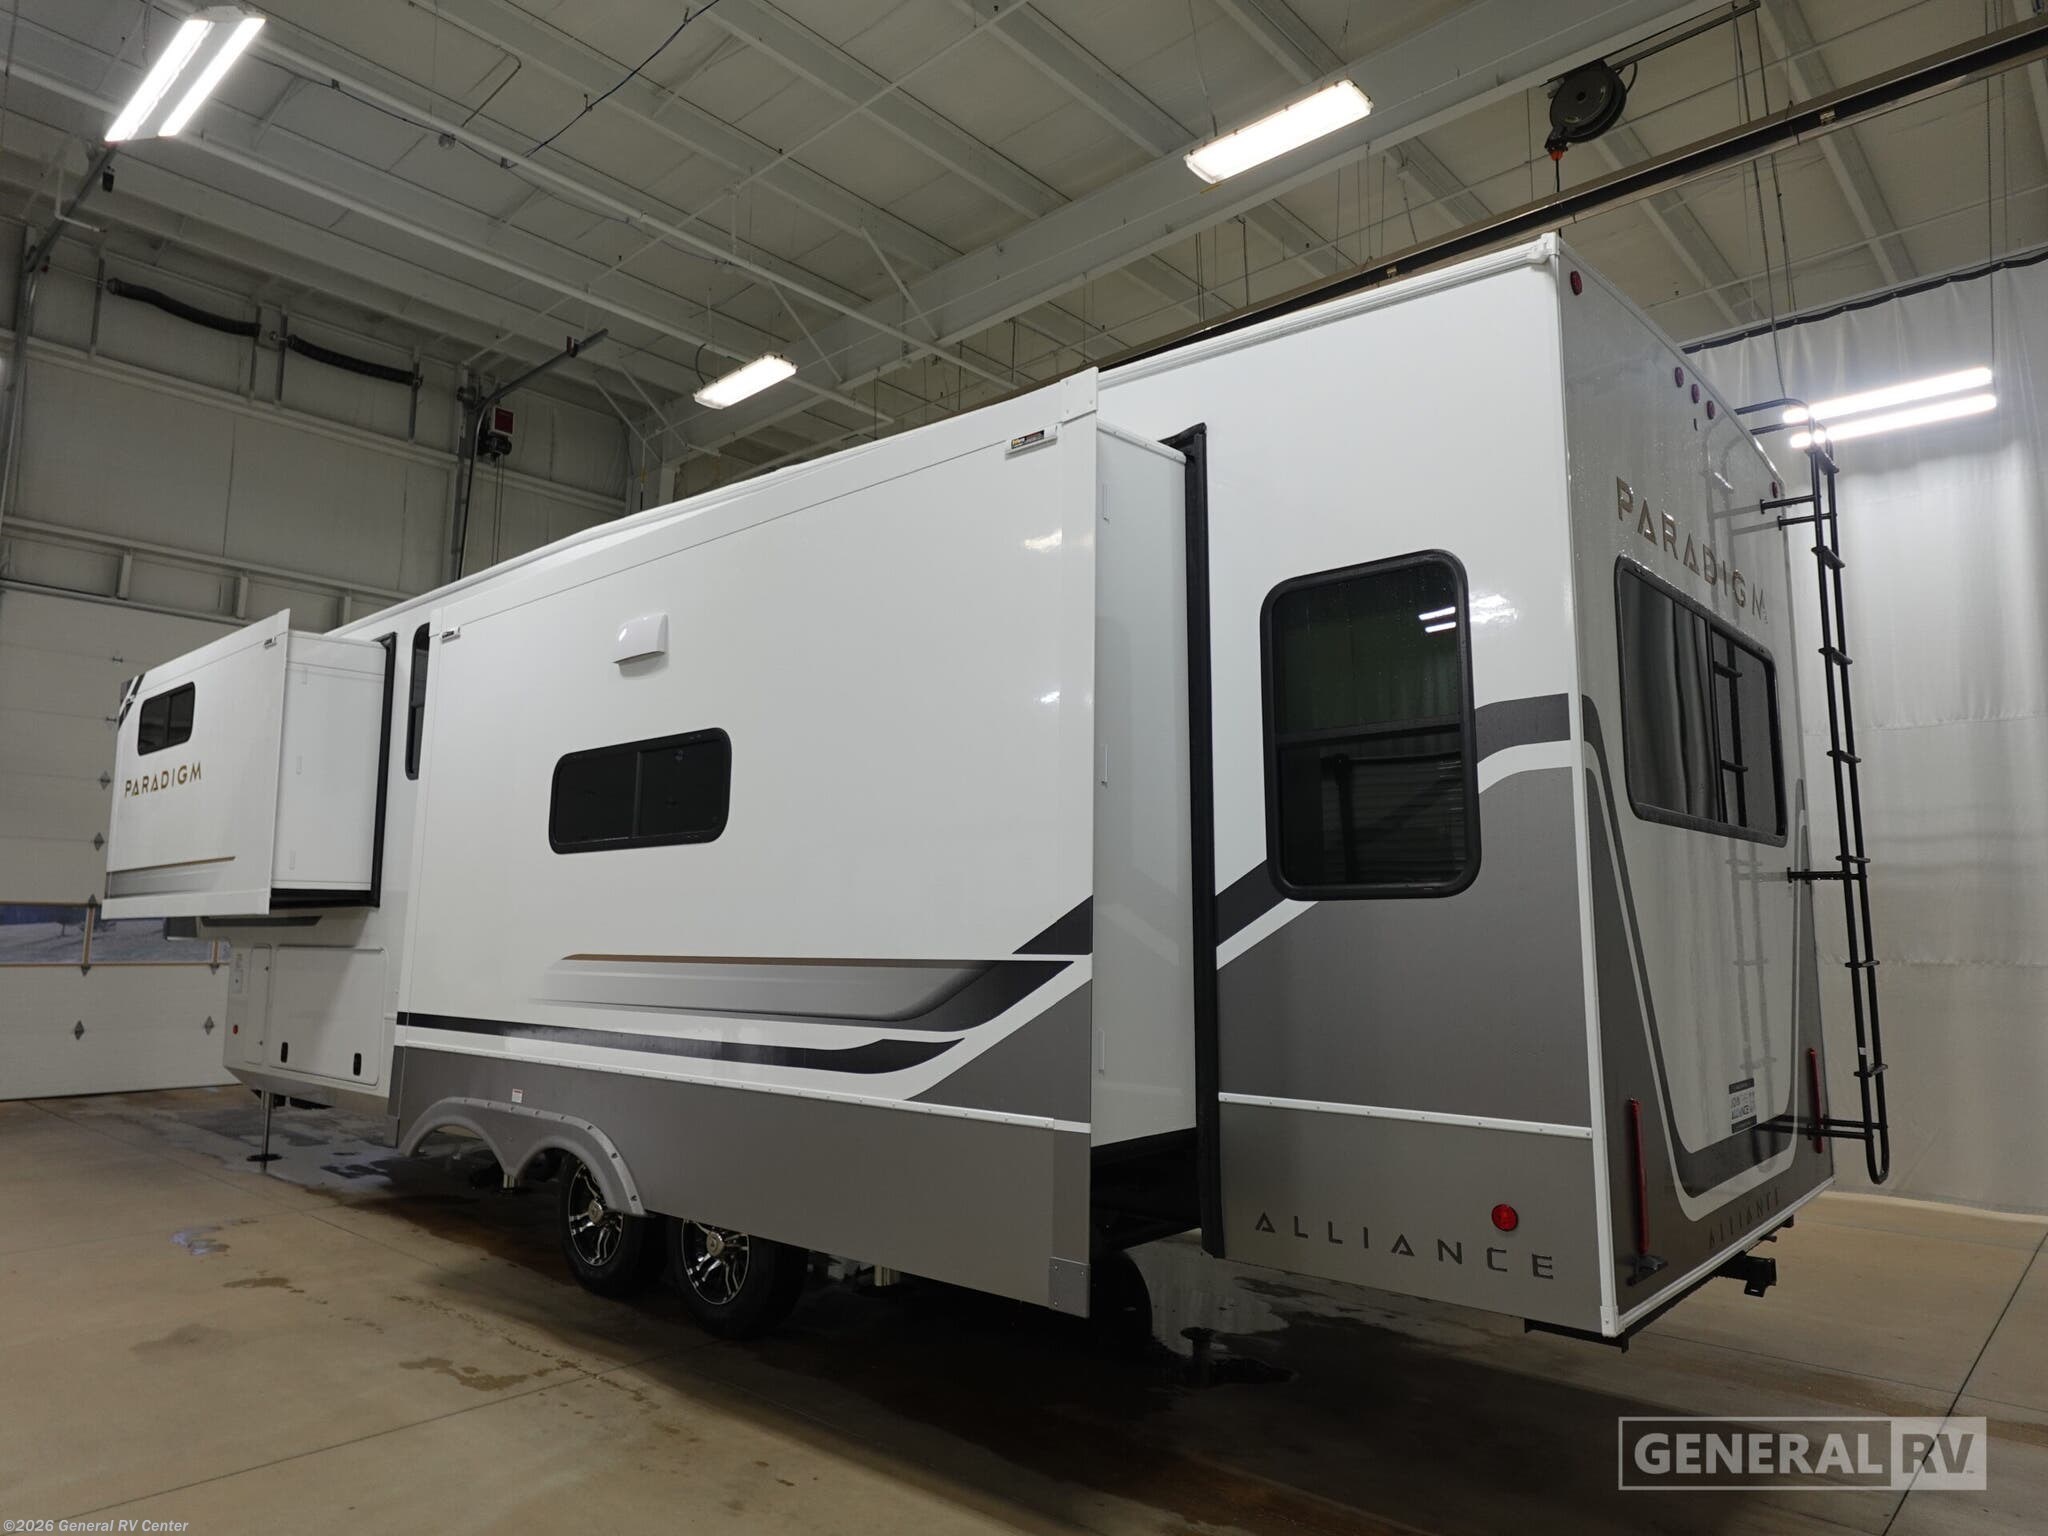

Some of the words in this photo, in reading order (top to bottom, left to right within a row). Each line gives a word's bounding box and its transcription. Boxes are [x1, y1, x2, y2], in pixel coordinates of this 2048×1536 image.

[1616, 476, 1766, 621] PARADIGM
[124, 762, 202, 798] PARADIGM
[1255, 1211, 1554, 1280] ALLIANCE
